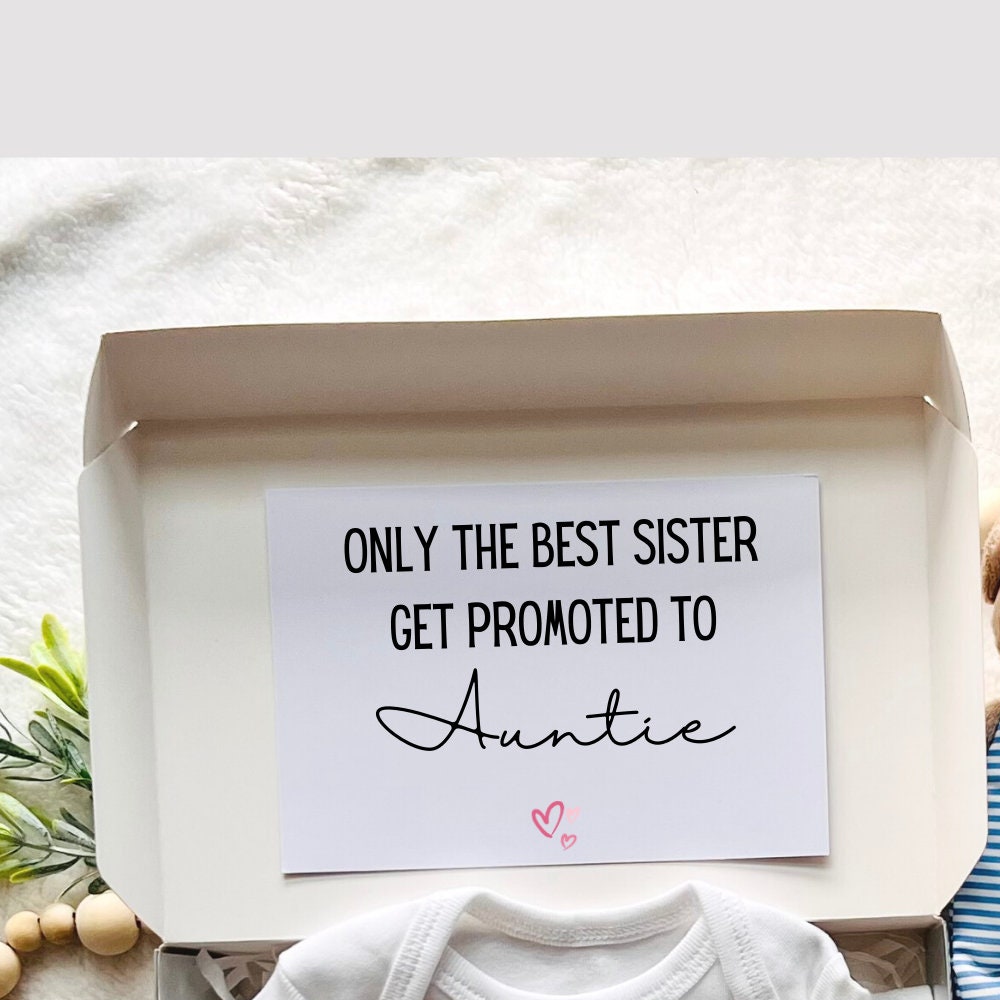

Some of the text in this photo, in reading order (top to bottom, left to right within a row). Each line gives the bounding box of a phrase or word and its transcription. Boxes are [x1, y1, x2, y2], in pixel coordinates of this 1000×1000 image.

[343, 515, 759, 574] ONLY THE BEST SISTER
[390, 594, 717, 651] GET PROMOTED TO
[375, 667, 737, 752] Auntie
